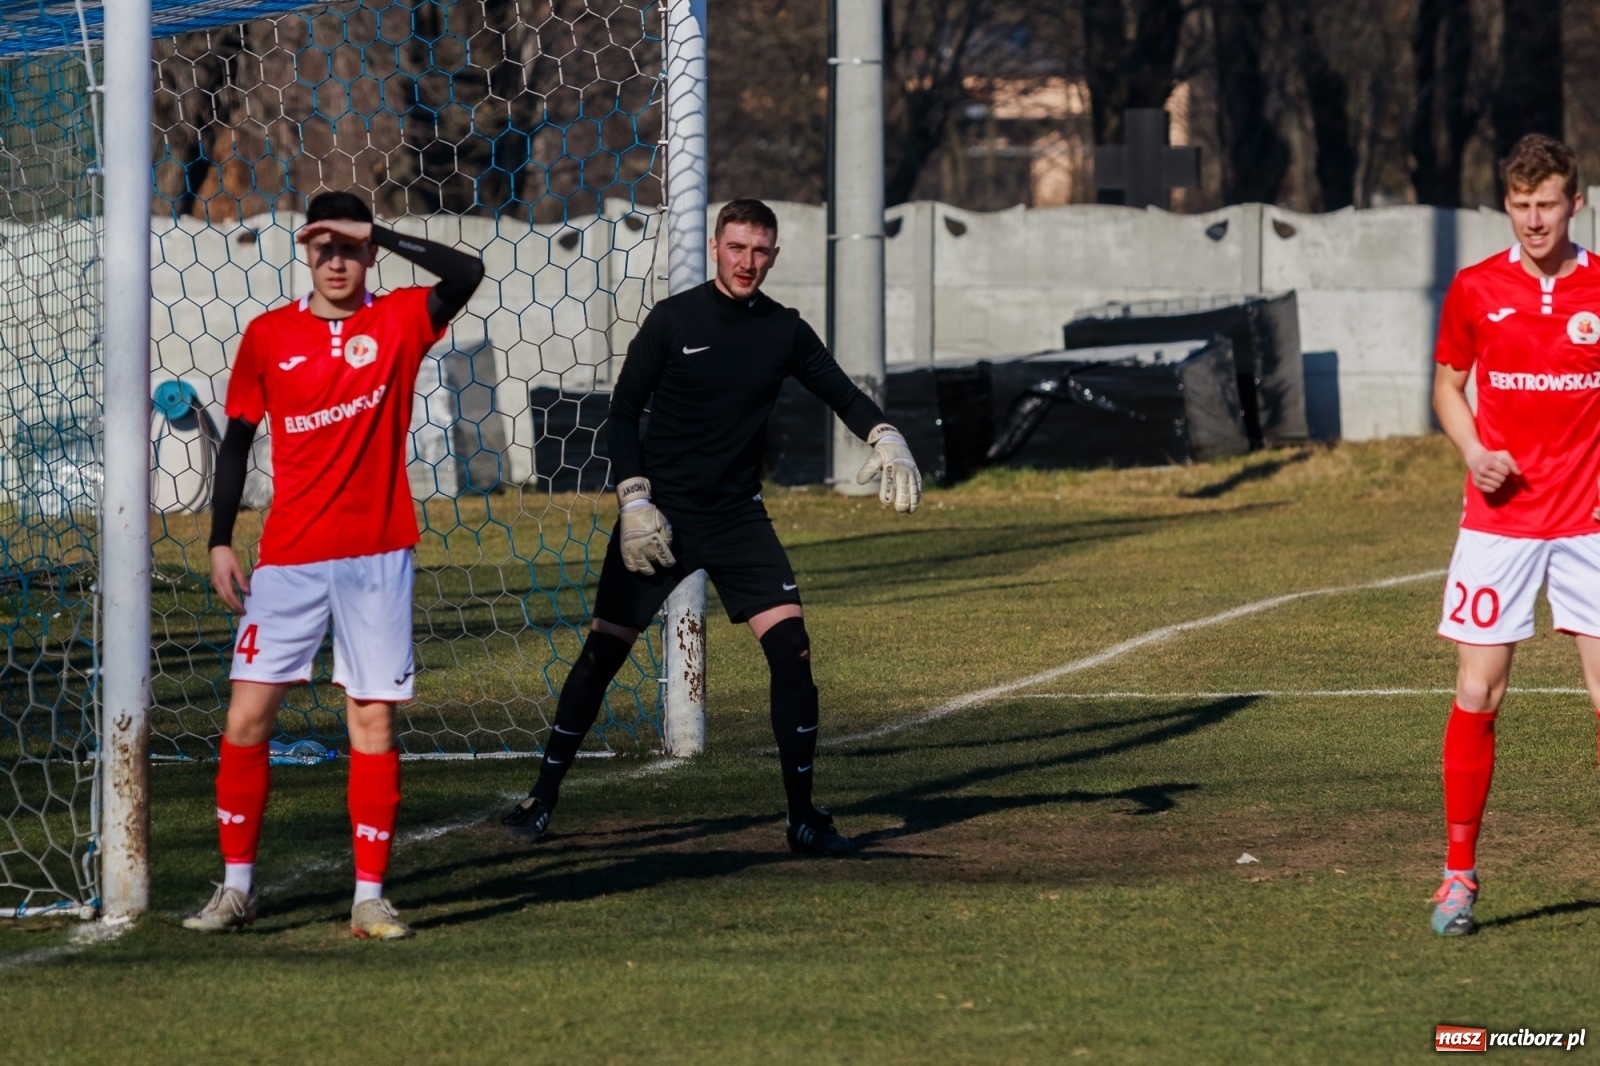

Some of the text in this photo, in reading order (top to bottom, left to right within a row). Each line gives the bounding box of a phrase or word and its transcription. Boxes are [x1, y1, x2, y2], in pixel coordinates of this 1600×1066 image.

[1488, 371, 1600, 391] EEKTROWSKAZ
[1450, 581, 1499, 628] 20
[236, 624, 260, 664] 4
